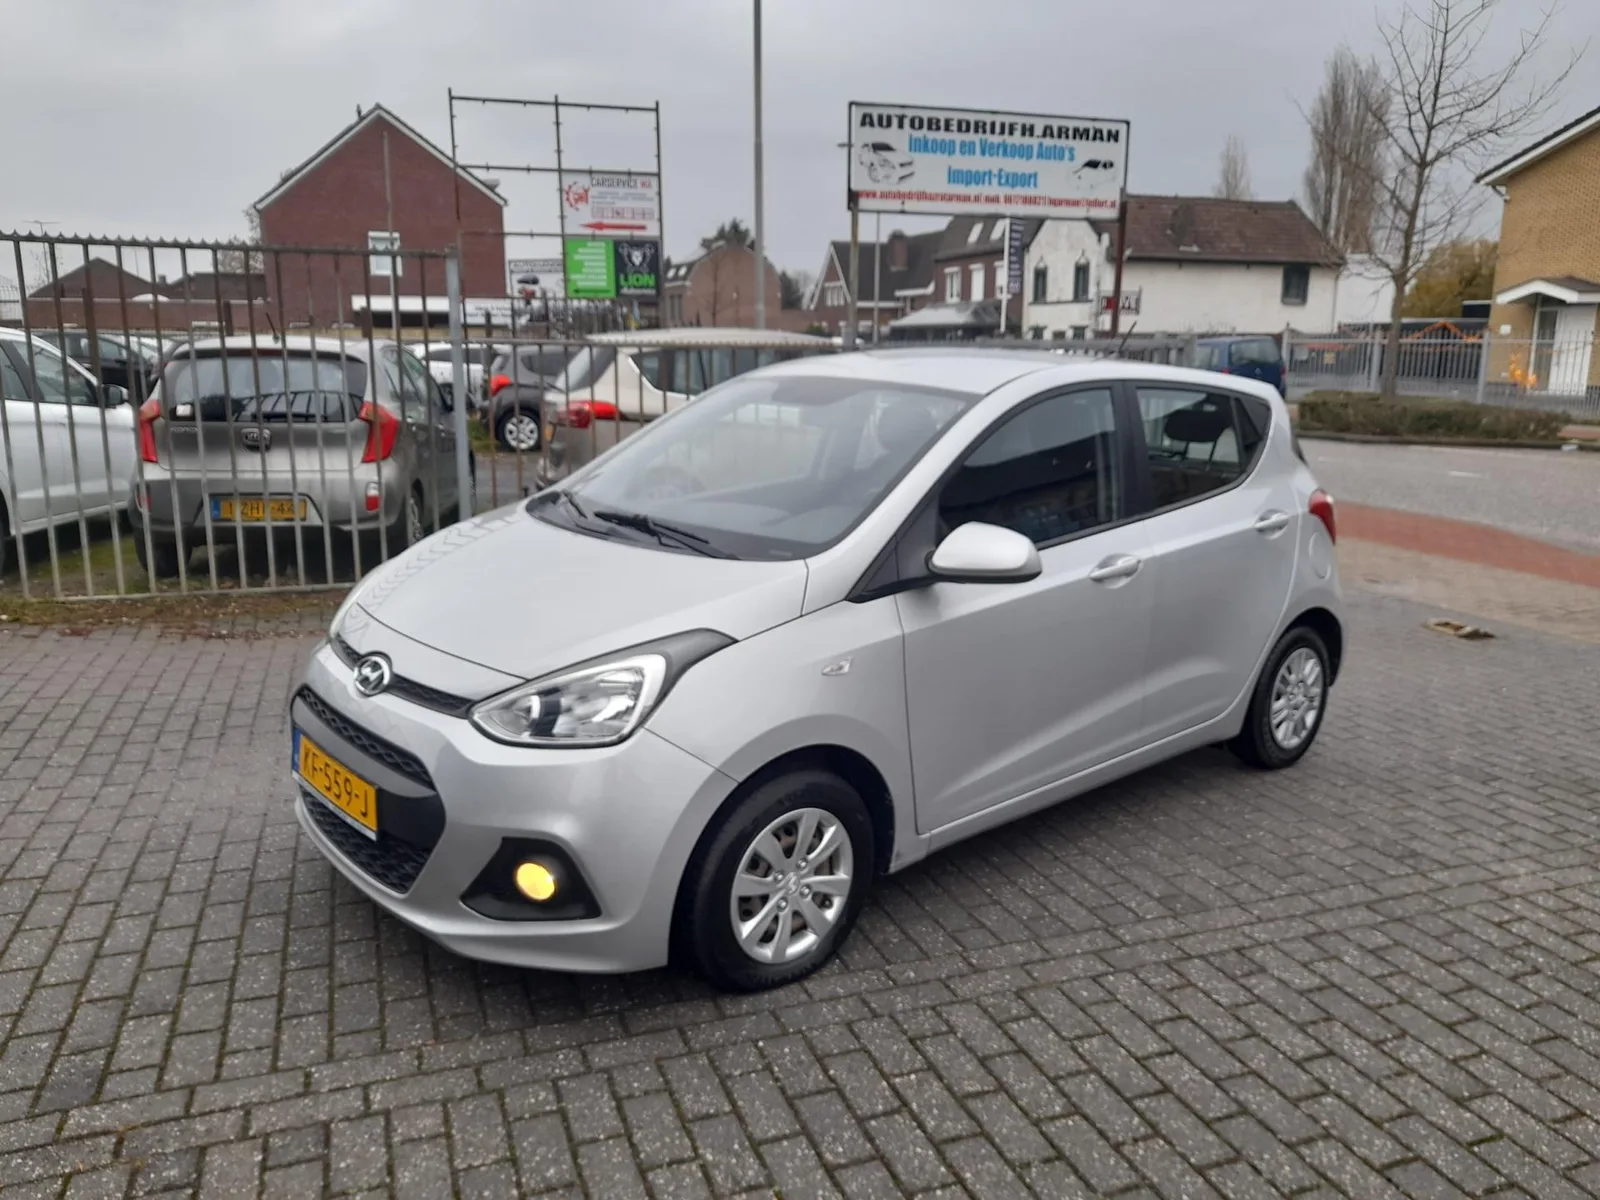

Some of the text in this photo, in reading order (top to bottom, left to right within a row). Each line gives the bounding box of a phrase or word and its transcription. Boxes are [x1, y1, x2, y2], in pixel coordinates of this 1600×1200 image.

[908, 133, 1076, 161] Inkoop en Verkoop Auto's
[947, 166, 1038, 188] Import-Export
[620, 273, 656, 287] LION
[302, 744, 369, 818] KF-559-J
